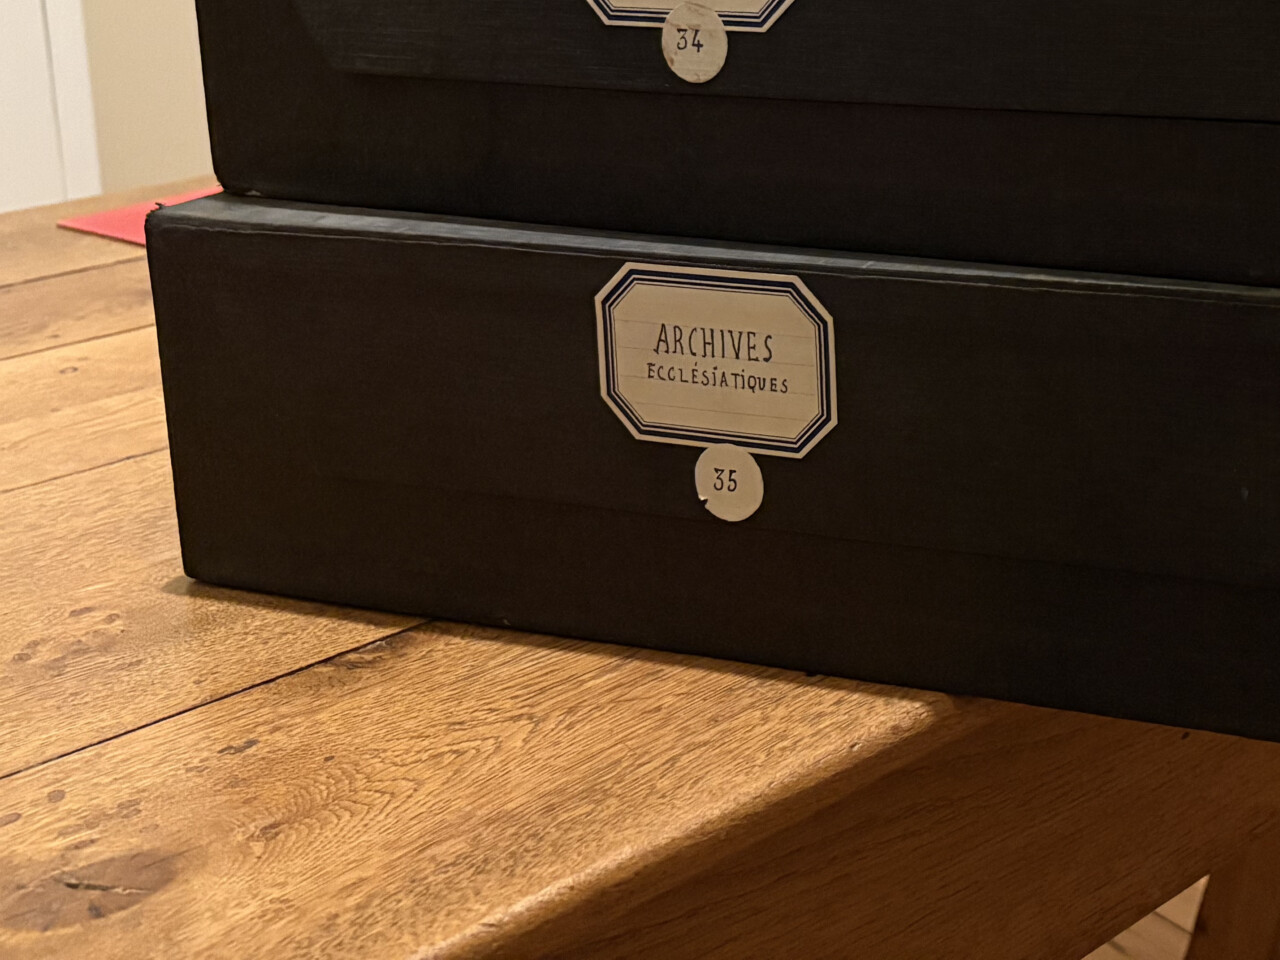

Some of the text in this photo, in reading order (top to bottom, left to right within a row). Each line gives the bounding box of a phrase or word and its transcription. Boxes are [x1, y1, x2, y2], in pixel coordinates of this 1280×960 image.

[676, 28, 704, 53] 34
[653, 323, 773, 363] ARCHIVES
[646, 361, 789, 394] ECCLÉSIATIQUES
[713, 467, 738, 492] 35
